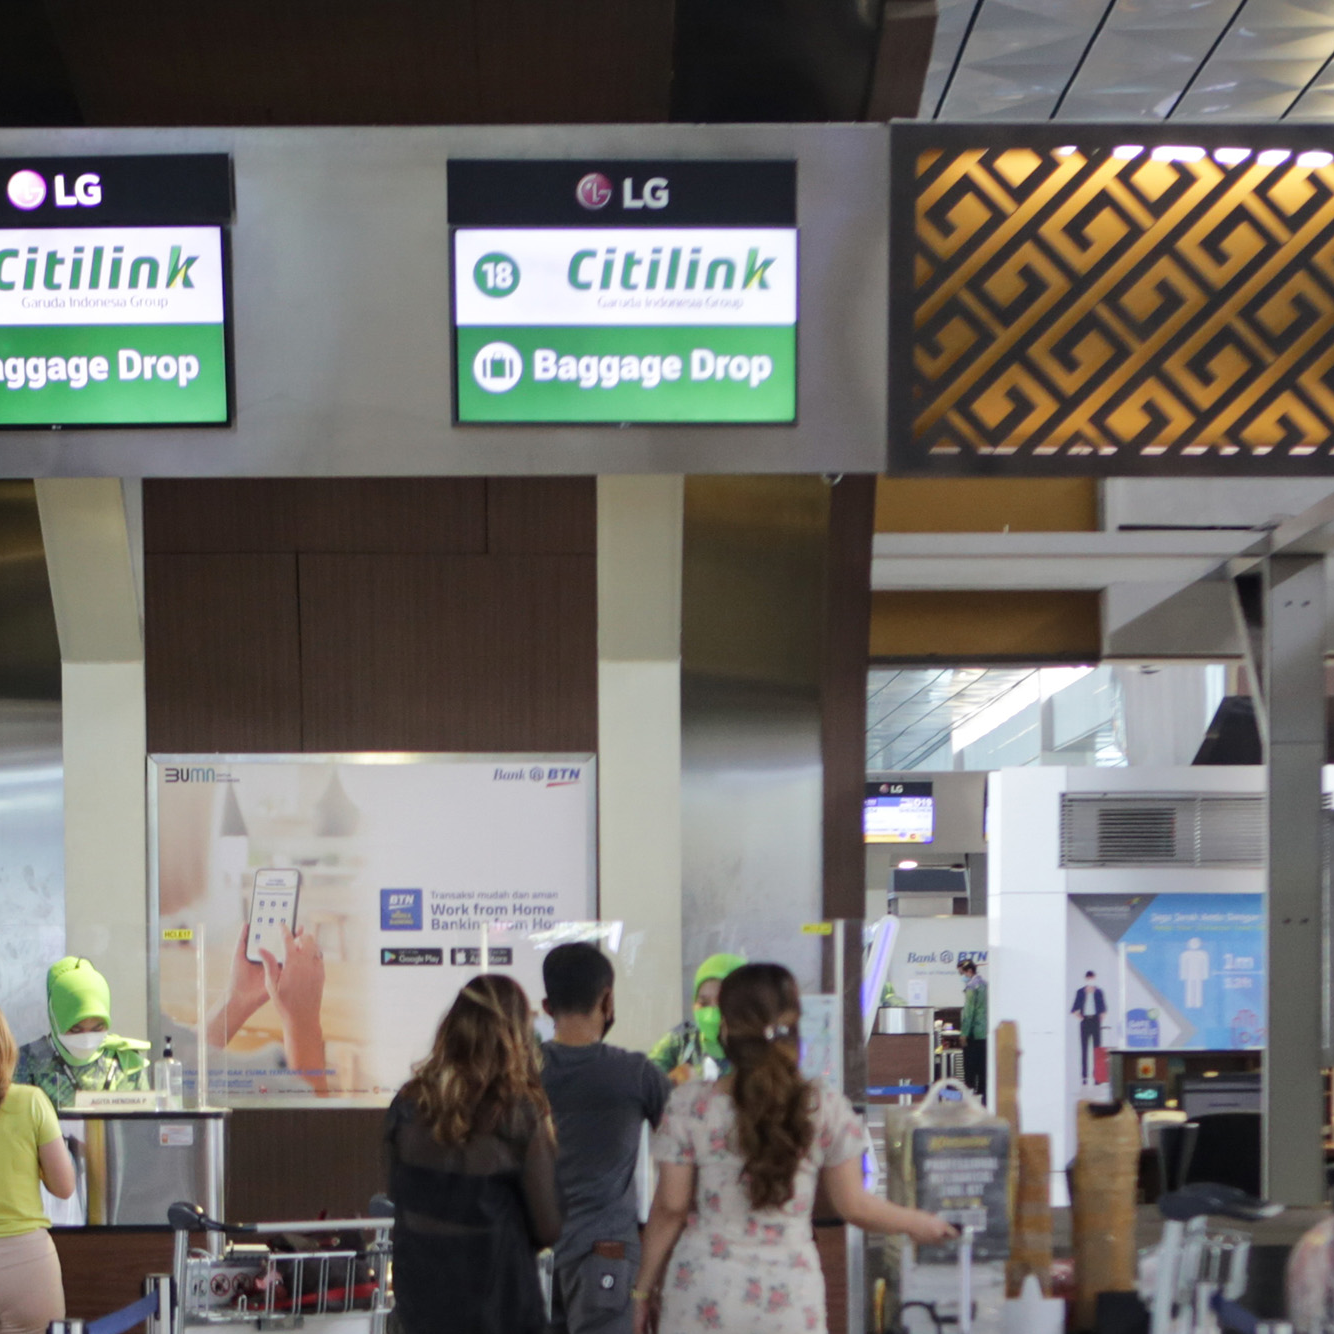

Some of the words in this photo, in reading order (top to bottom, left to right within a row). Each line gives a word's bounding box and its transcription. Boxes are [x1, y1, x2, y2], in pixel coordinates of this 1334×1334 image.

[54, 174, 102, 207] LG
[623, 177, 669, 209] LG
[481, 262, 513, 289] 18
[567, 247, 776, 291] Citilink
[21, 297, 66, 308] Garuda
[69, 297, 127, 308] Indonesia
[129, 297, 168, 309] Group
[118, 349, 199, 387] Drop
[533, 349, 682, 388] Baggage
[690, 349, 772, 387] Drop
[165, 768, 215, 783] BUMN
[493, 768, 525, 781] Bank
[547, 768, 581, 781] BTN
[890, 784, 903, 794] LG
[431, 891, 474, 900] Transaksi
[477, 891, 509, 900] mudah
[512, 891, 529, 900] dan
[532, 892, 558, 900] aman
[431, 904, 468, 916] Work
[473, 903, 507, 916] from
[513, 903, 555, 916] Home
[431, 918, 489, 932] Bankin
[907, 952, 936, 963] Bank
[1223, 953, 1254, 970] 1m
